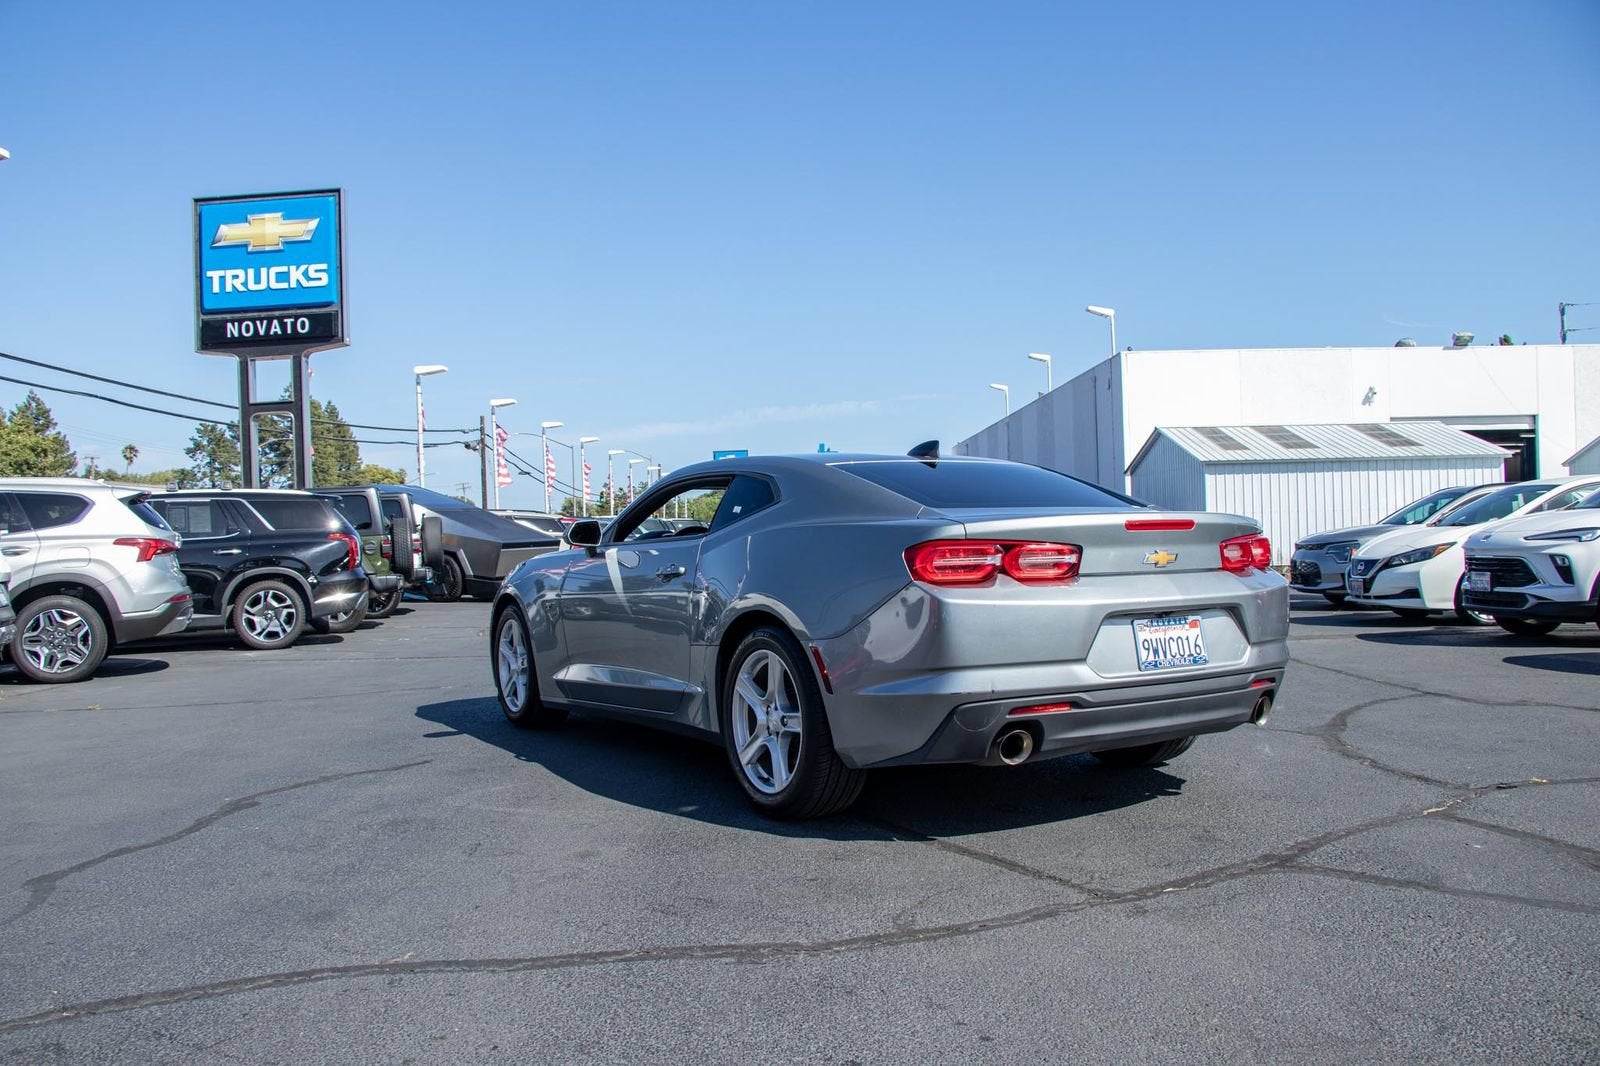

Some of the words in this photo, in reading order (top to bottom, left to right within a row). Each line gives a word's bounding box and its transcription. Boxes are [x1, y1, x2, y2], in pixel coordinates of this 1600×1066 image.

[206, 263, 329, 293] TRUCKS
[226, 317, 310, 338] NOVATO
[1142, 634, 1202, 660] 9WVC016
[1157, 658, 1193, 668] CHEVROLET
